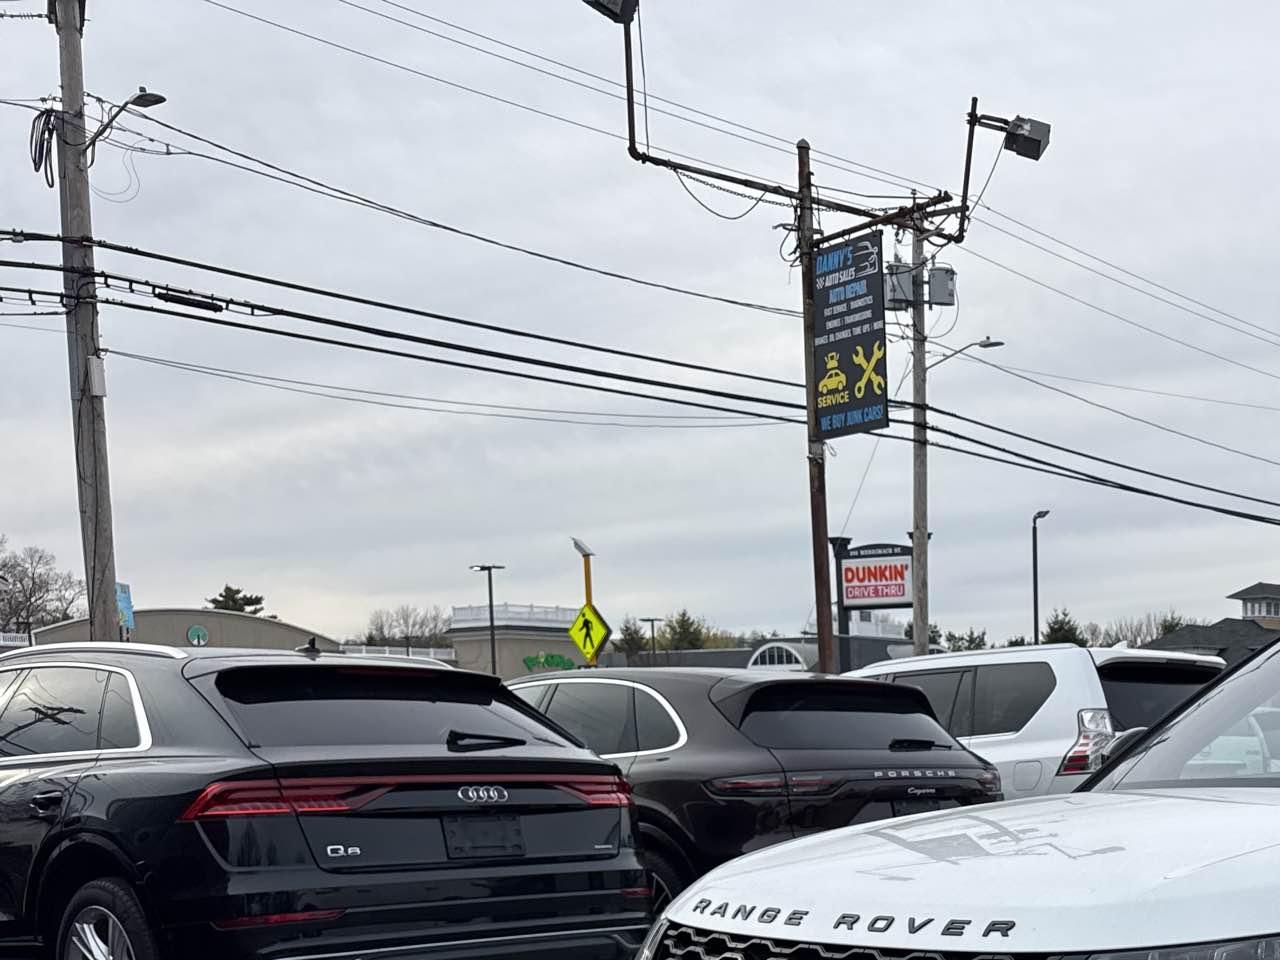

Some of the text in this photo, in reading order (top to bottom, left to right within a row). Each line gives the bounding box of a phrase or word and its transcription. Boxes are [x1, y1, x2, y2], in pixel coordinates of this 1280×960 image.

[824, 266, 856, 288] AUTO SALES
[817, 391, 849, 409] SERVICE
[832, 412, 846, 429] BUY
[844, 564, 908, 584] DUNKIN'
[847, 584, 904, 598] DRIVE THRU
[873, 770, 956, 778] PORSCHE
[326, 845, 361, 857] Q8
[692, 898, 1017, 938] RANGE ROVER
